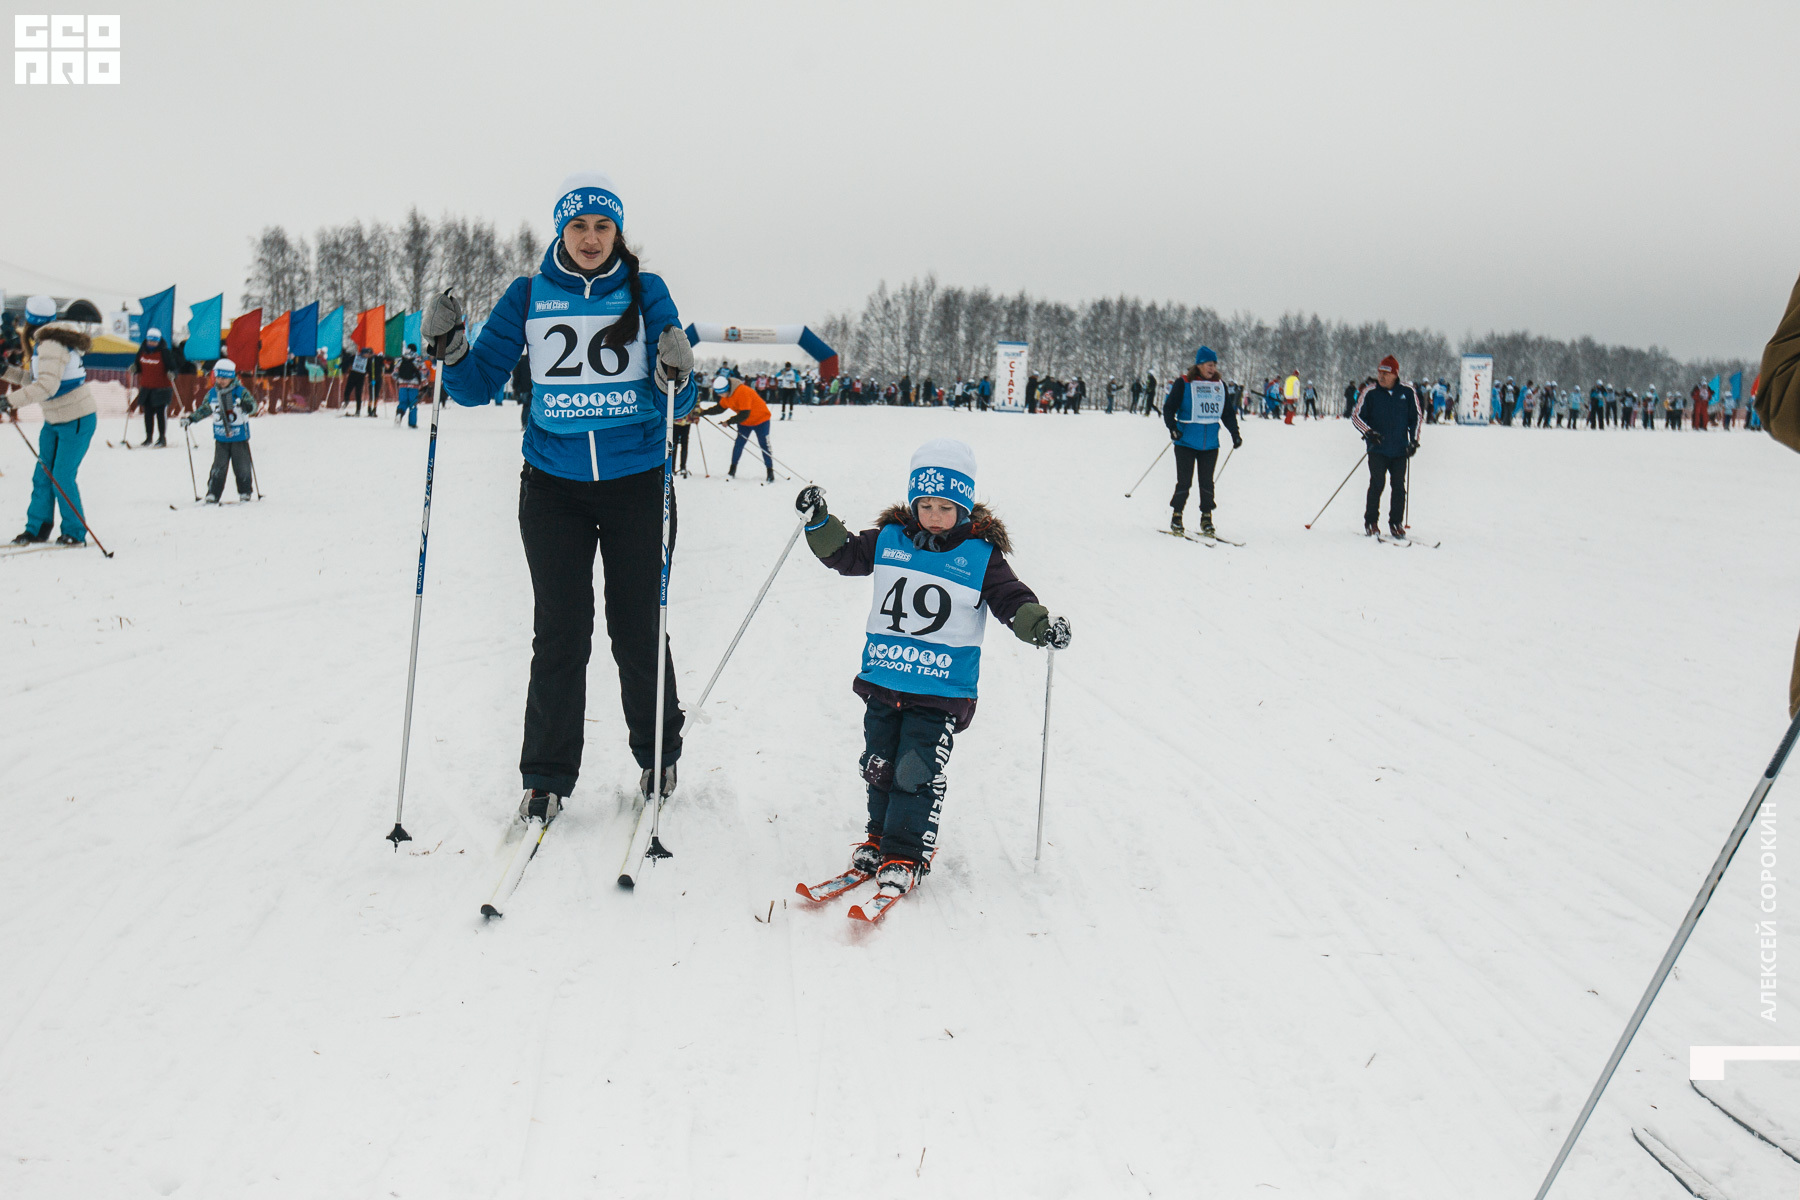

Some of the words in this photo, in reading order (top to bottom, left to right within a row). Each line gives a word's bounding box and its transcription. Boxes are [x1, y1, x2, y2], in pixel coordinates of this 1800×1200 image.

[536, 301, 552, 312] World
[552, 301, 569, 311] Class
[543, 324, 630, 376] 26
[1008, 361, 1016, 405] СТАРТ
[1473, 373, 1481, 418] СТАРТ
[544, 408, 604, 418] OUTDOOR
[606, 404, 638, 416] TEAM
[1200, 402, 1219, 414] 1093
[895, 549, 912, 562] Class
[880, 577, 952, 636] 49
[867, 659, 912, 673] OUTDOOR
[916, 665, 950, 679] TEAM
